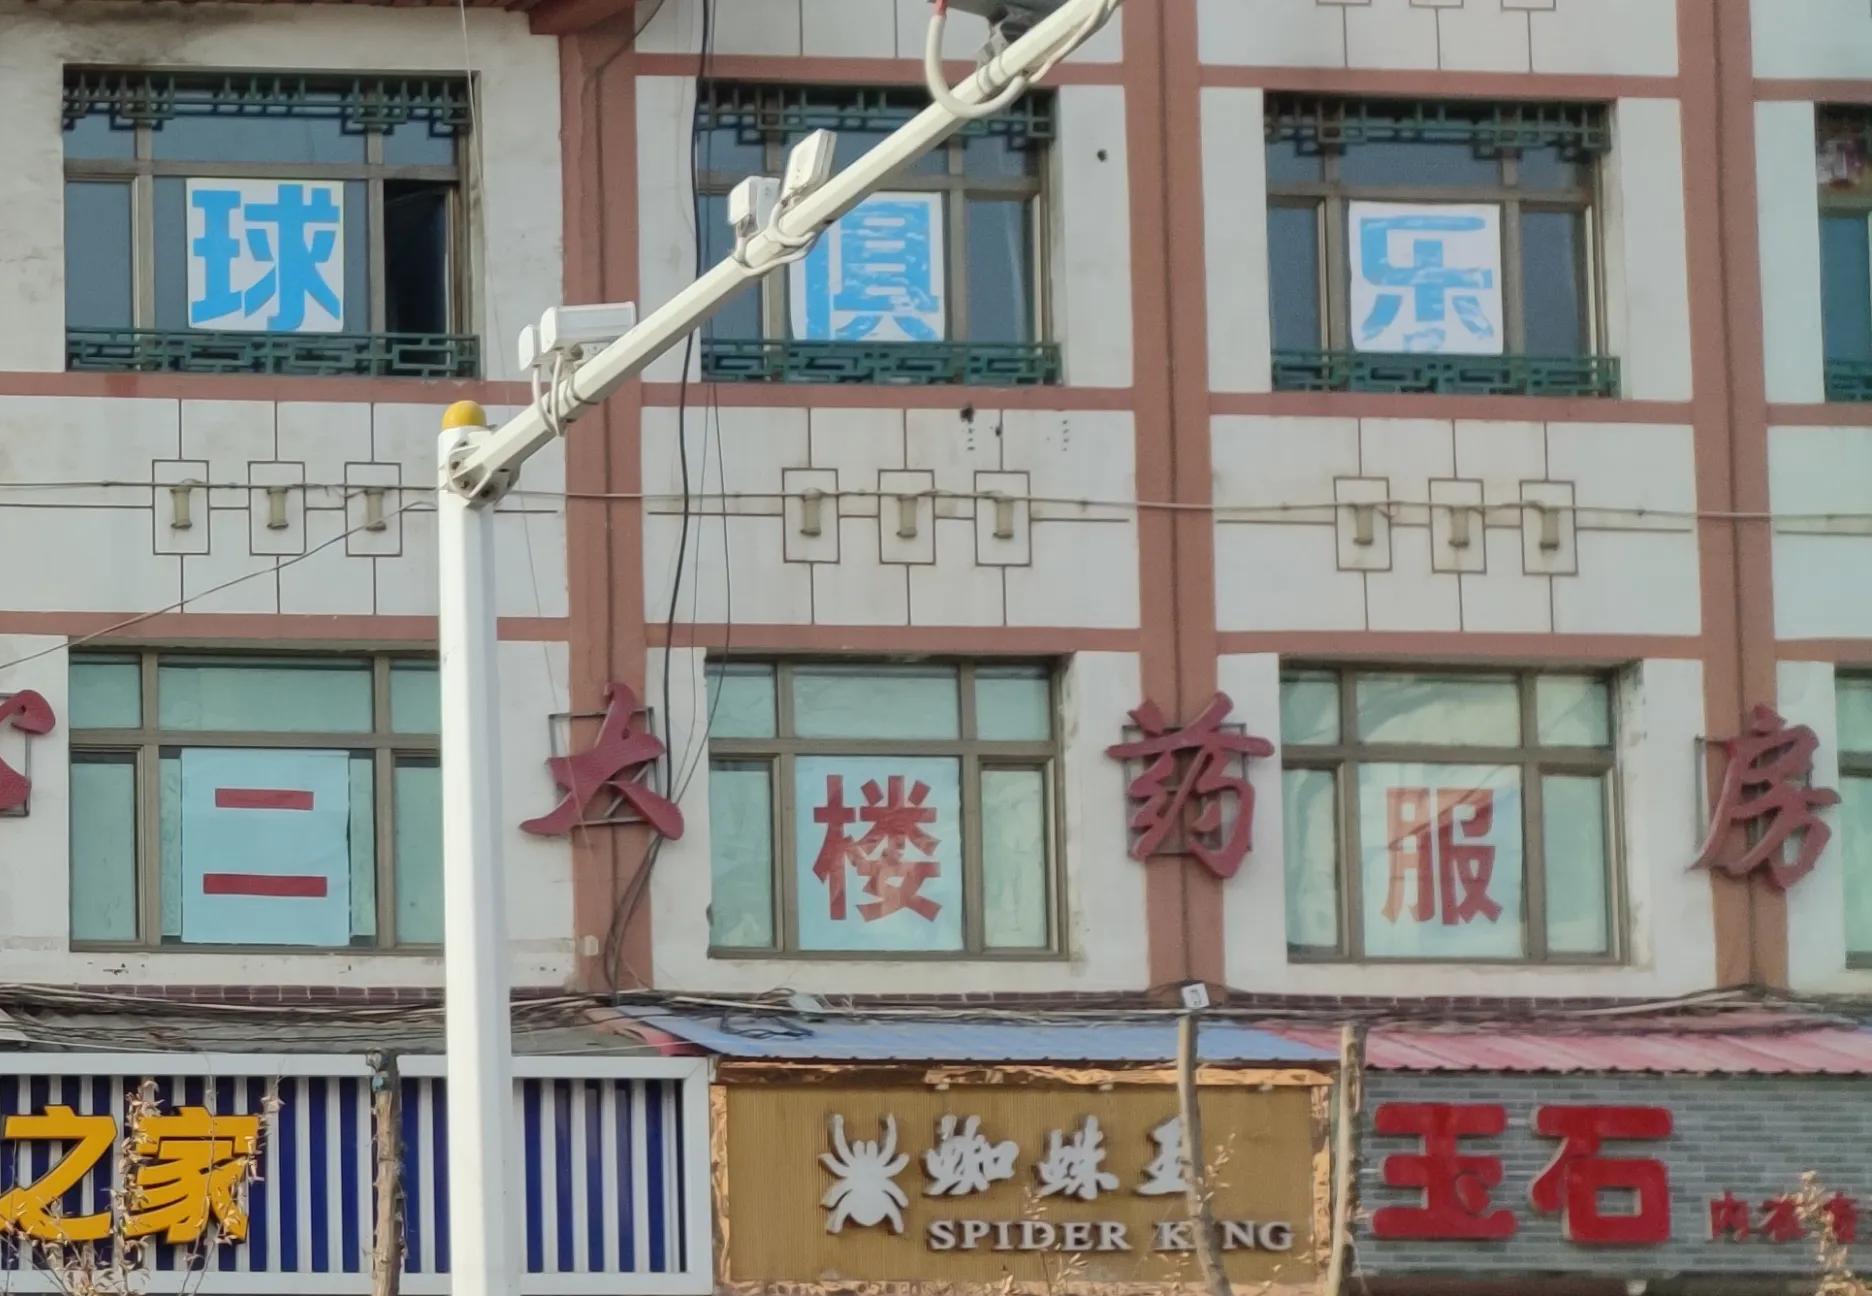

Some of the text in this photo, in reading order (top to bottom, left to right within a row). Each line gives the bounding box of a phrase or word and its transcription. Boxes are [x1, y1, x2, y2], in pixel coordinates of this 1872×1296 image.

[191, 184, 344, 332] 球
[805, 201, 940, 341] 俱
[1359, 215, 1494, 352] 乐
[202, 788, 328, 898] 二
[812, 774, 941, 923] 楼
[1381, 787, 1503, 927] 服
[928, 1219, 1294, 1251] SPIDER KNG
[1370, 1101, 1674, 1244] 玉石
